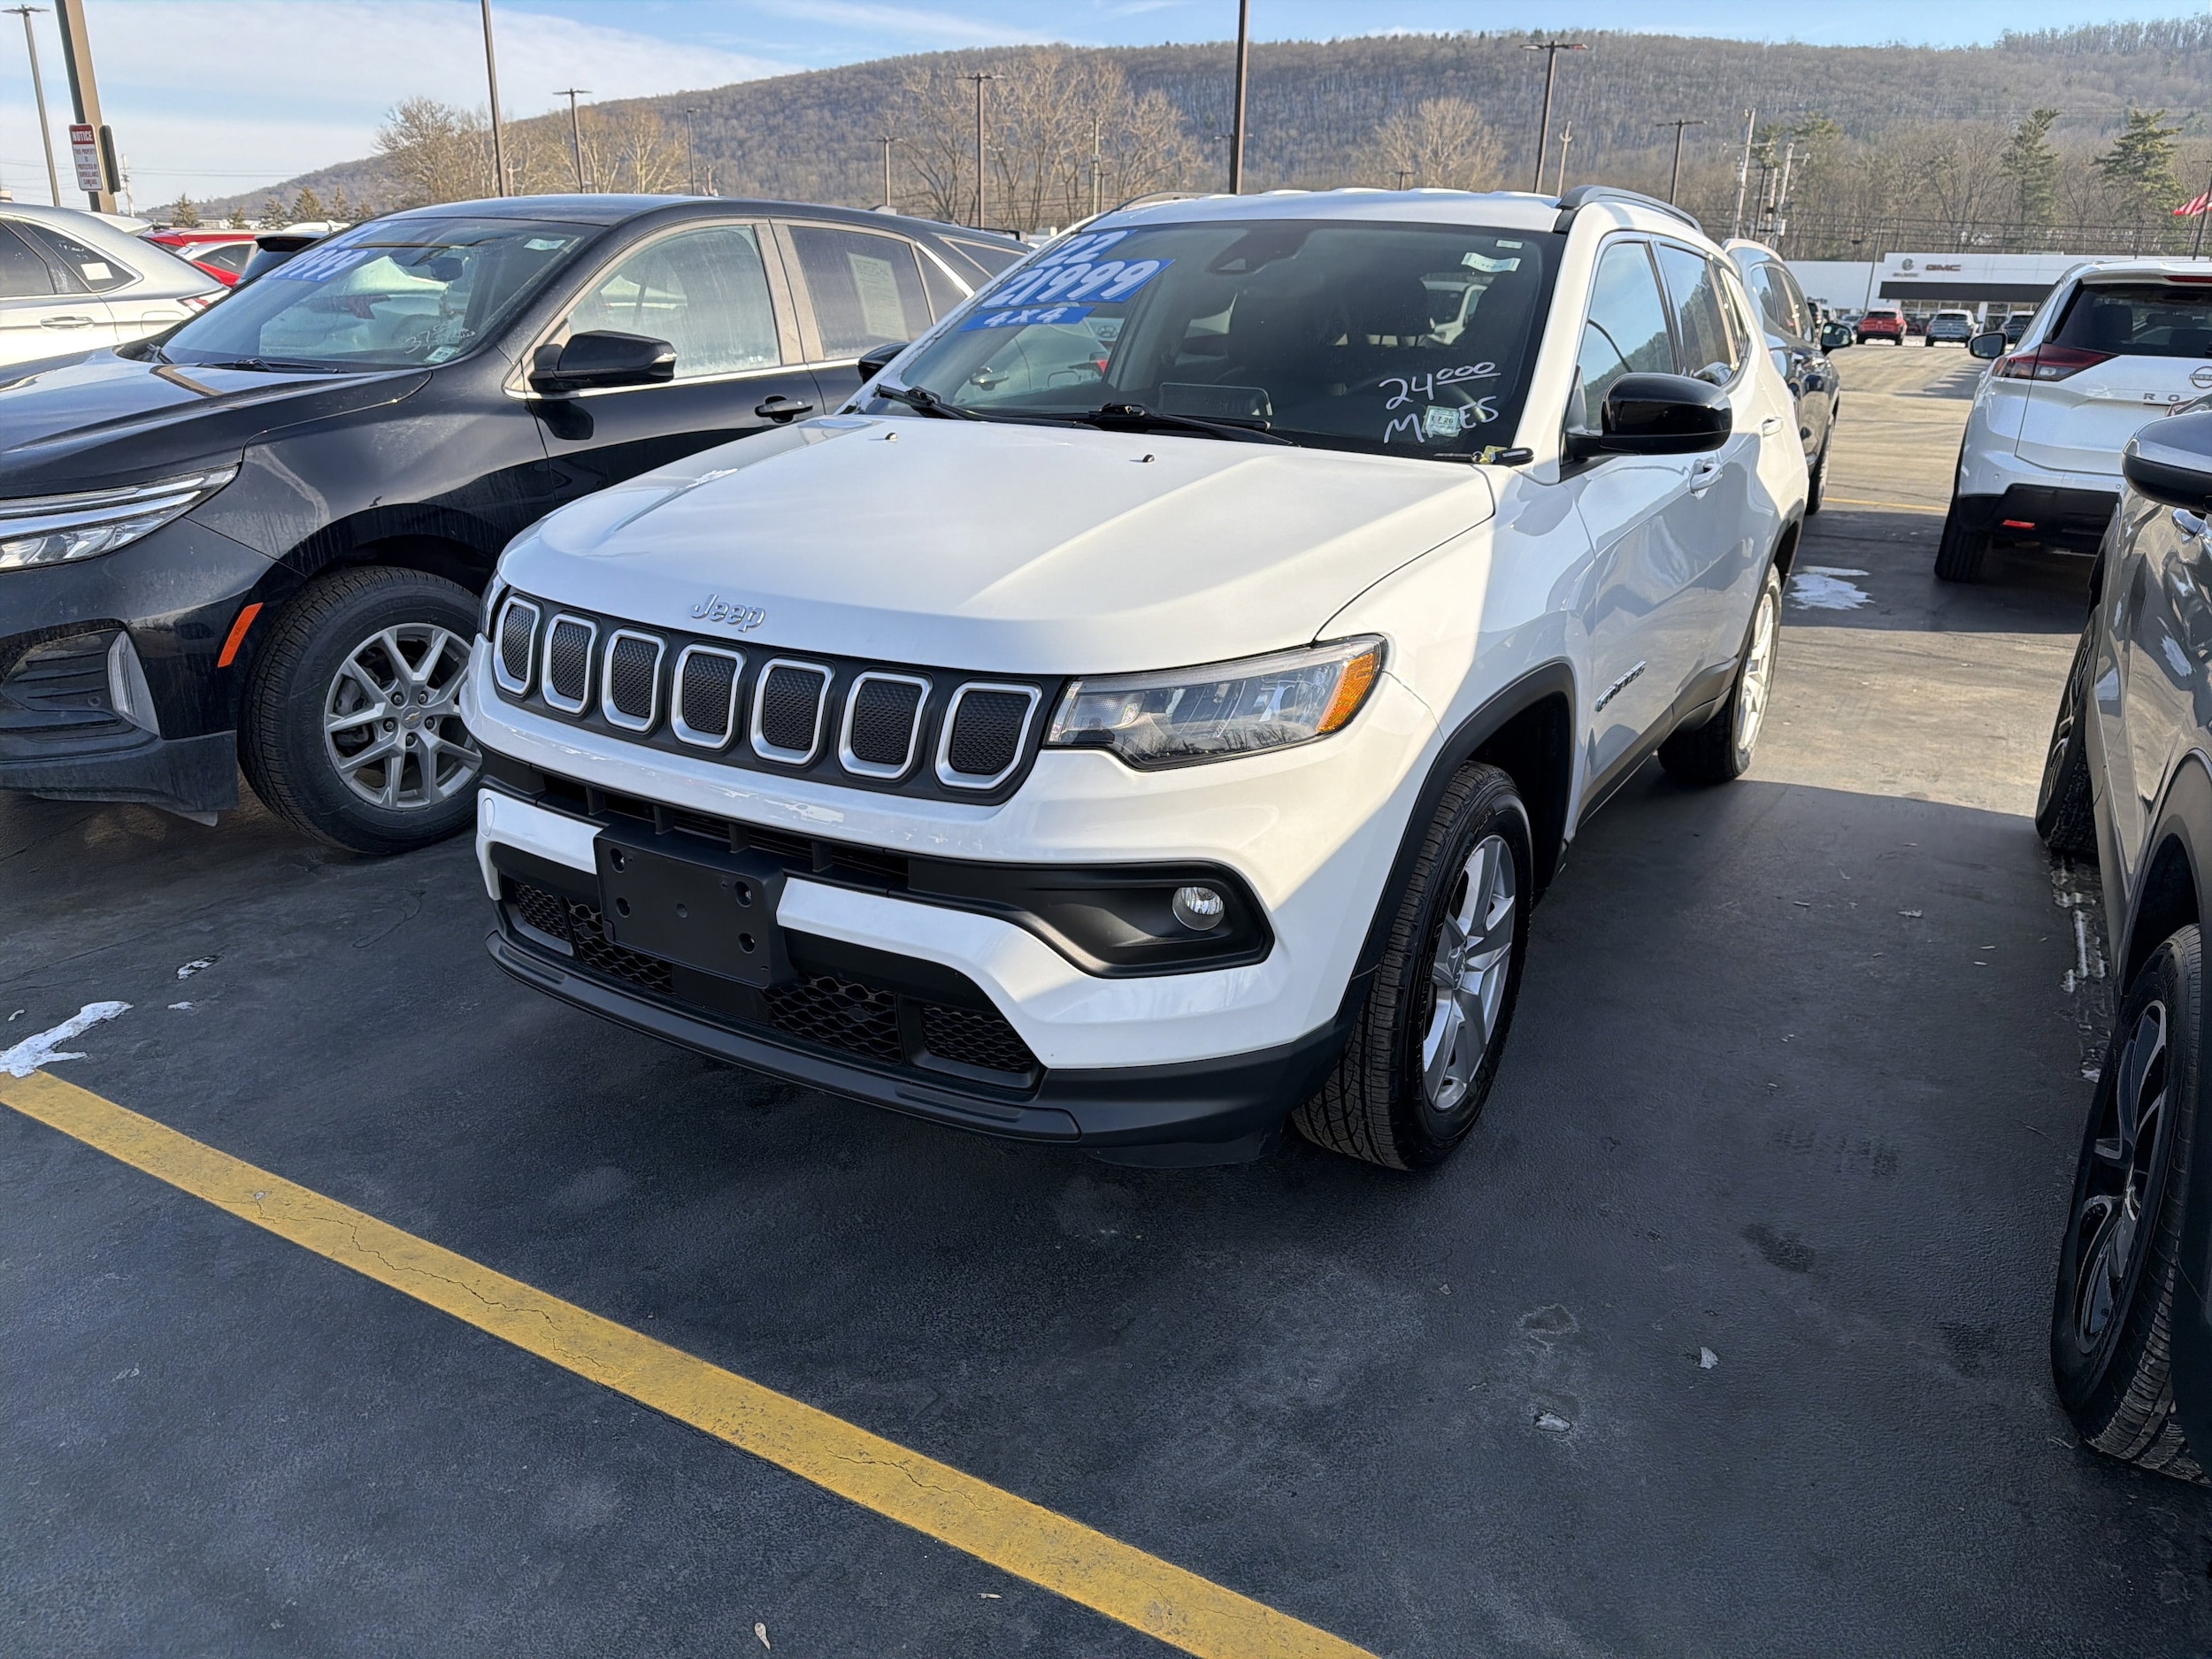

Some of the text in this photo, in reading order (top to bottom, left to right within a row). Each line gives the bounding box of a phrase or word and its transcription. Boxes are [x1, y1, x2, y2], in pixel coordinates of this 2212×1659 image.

[72, 131, 93, 142] NOTICE
[1034, 231, 1128, 268] 22
[981, 260, 1160, 307] 21999
[690, 594, 766, 634] Jeep
